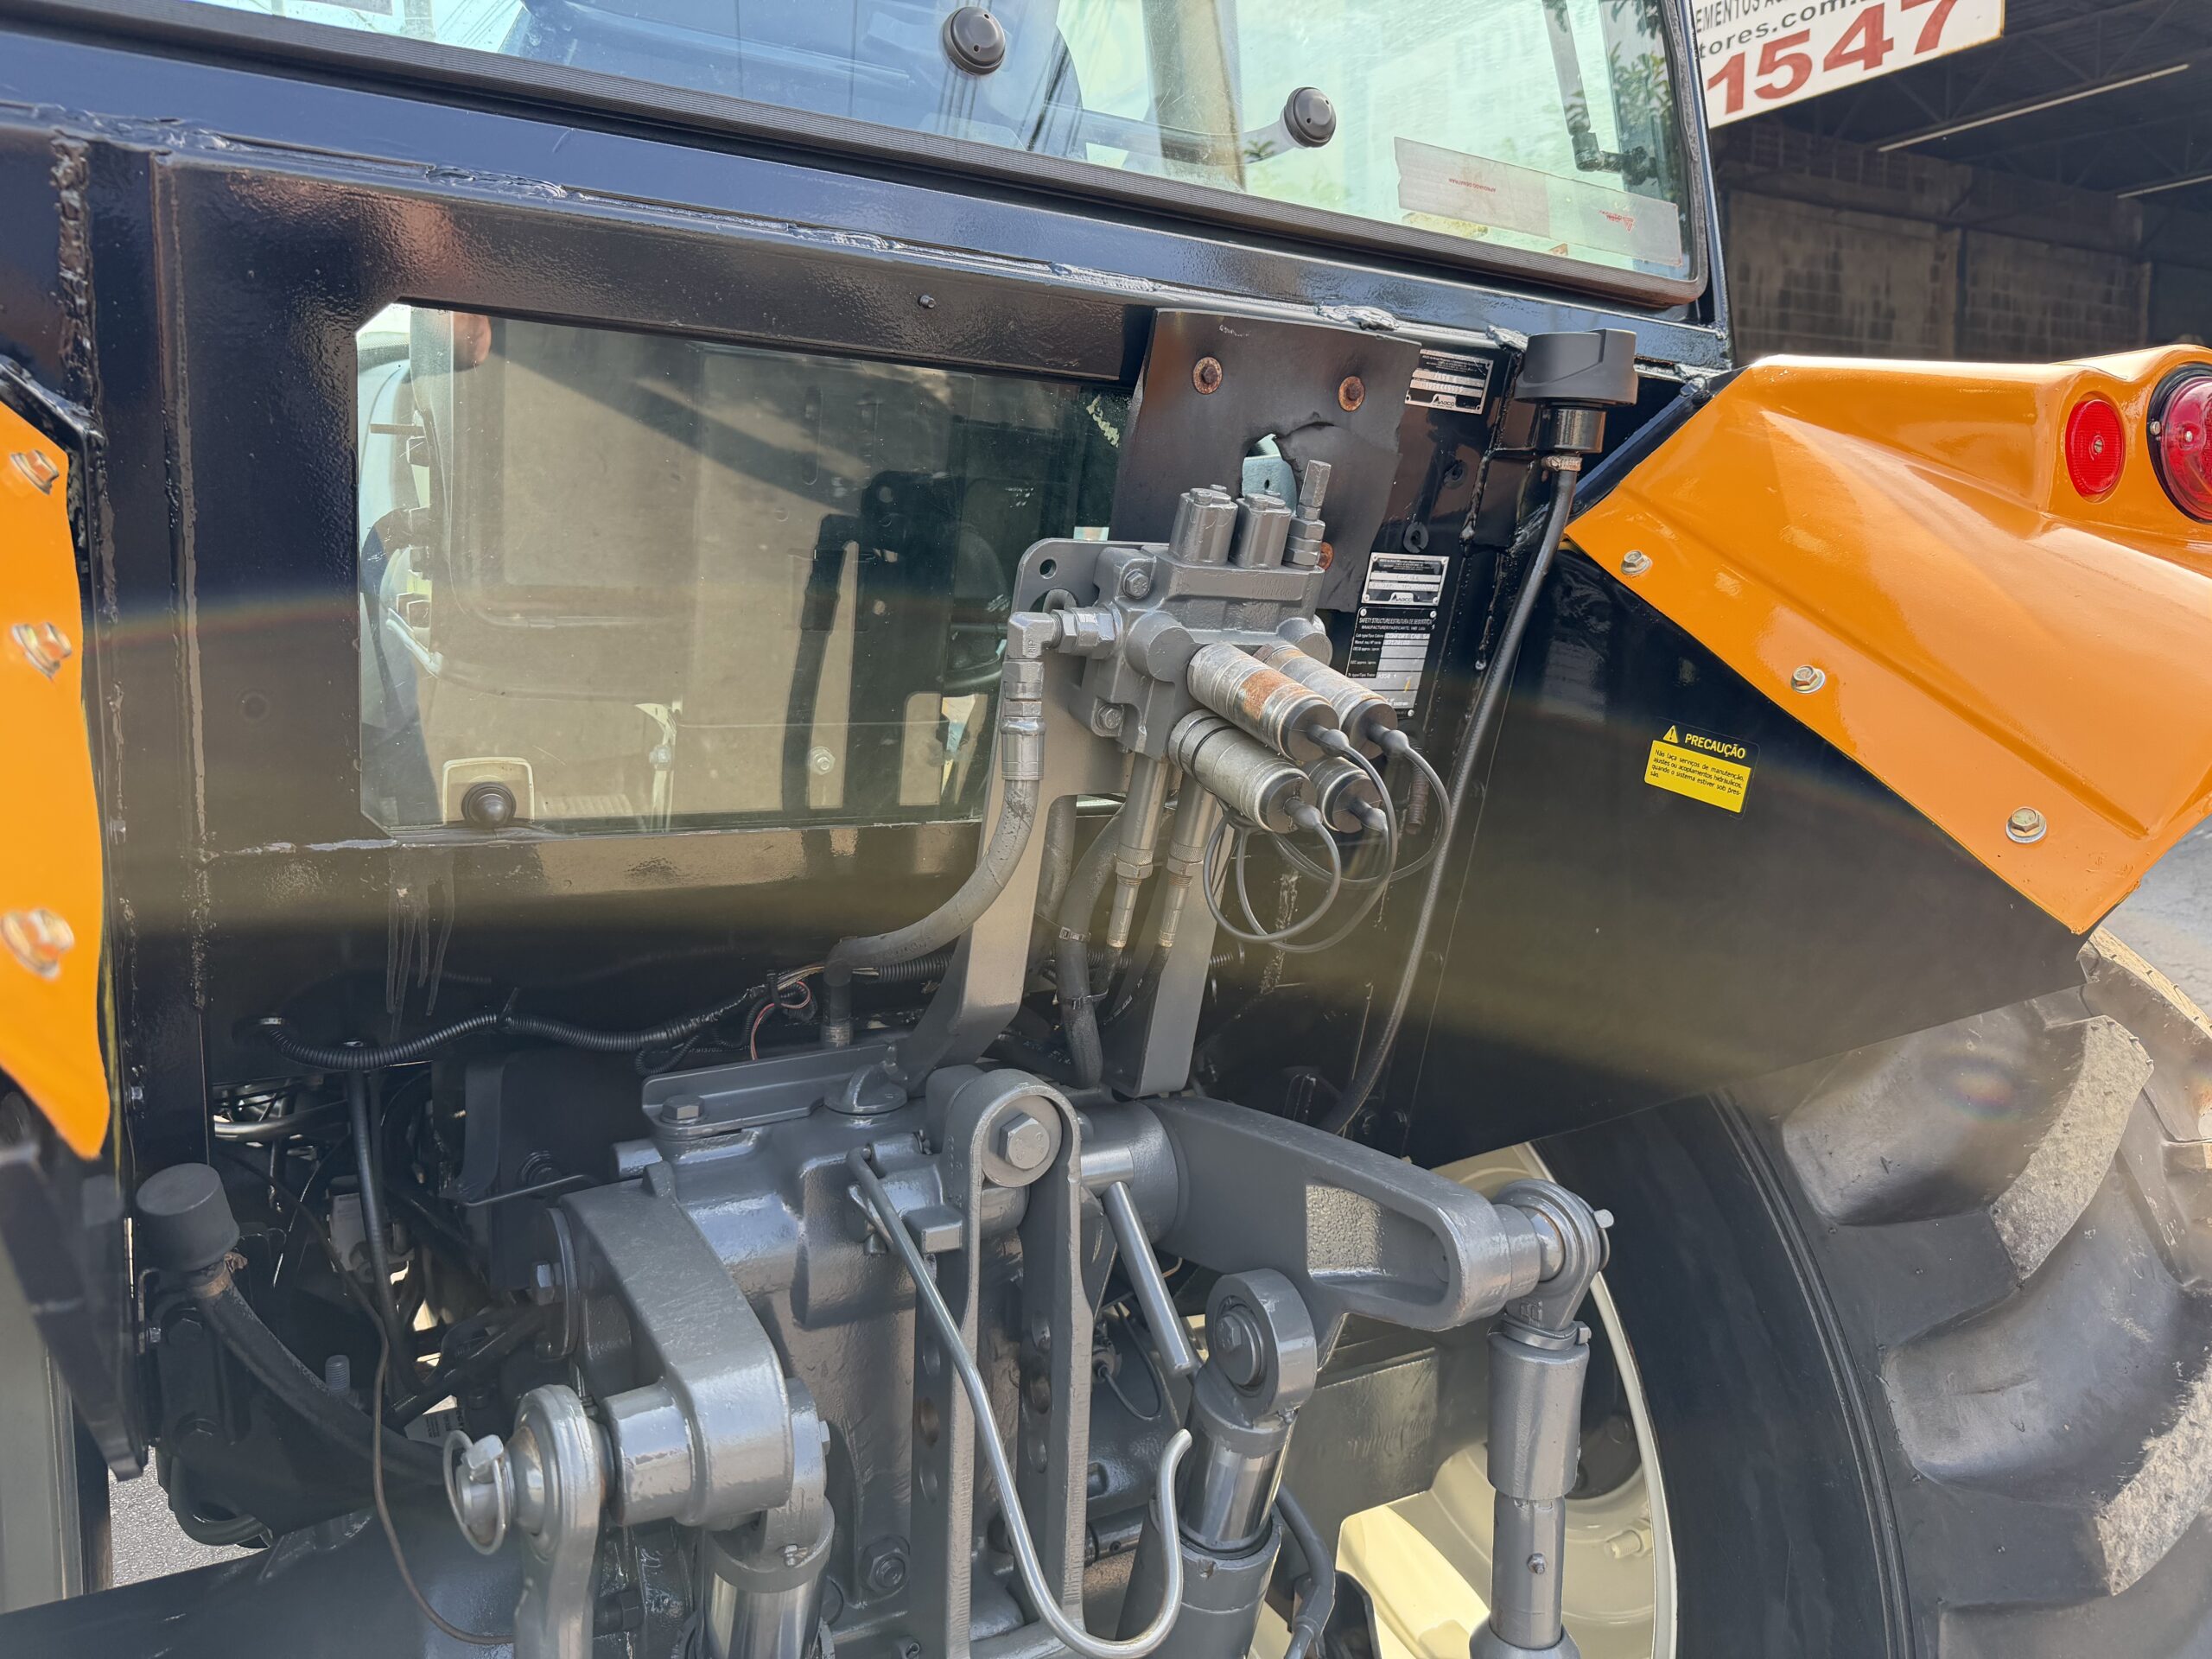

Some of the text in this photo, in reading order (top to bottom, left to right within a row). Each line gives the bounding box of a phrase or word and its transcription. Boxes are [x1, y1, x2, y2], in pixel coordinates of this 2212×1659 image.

[1700, 0, 1868, 59] tores.com.
[1707, 0, 1959, 116] 1547
[1685, 734, 1745, 759] PRECAUÇÃO
[1652, 764, 1670, 774] quando
[1676, 772, 1696, 782] sistema
[1696, 778, 1715, 788] estiver
[1727, 787, 1742, 796] pres-
[1653, 757, 1670, 766] ajustes
[1678, 765, 1713, 779] acoplamentos
[1655, 748, 1665, 758] Não
[1667, 753, 1677, 761] faça
[1679, 758, 1700, 768] serviços
[1710, 767, 1745, 783] manutenção,
